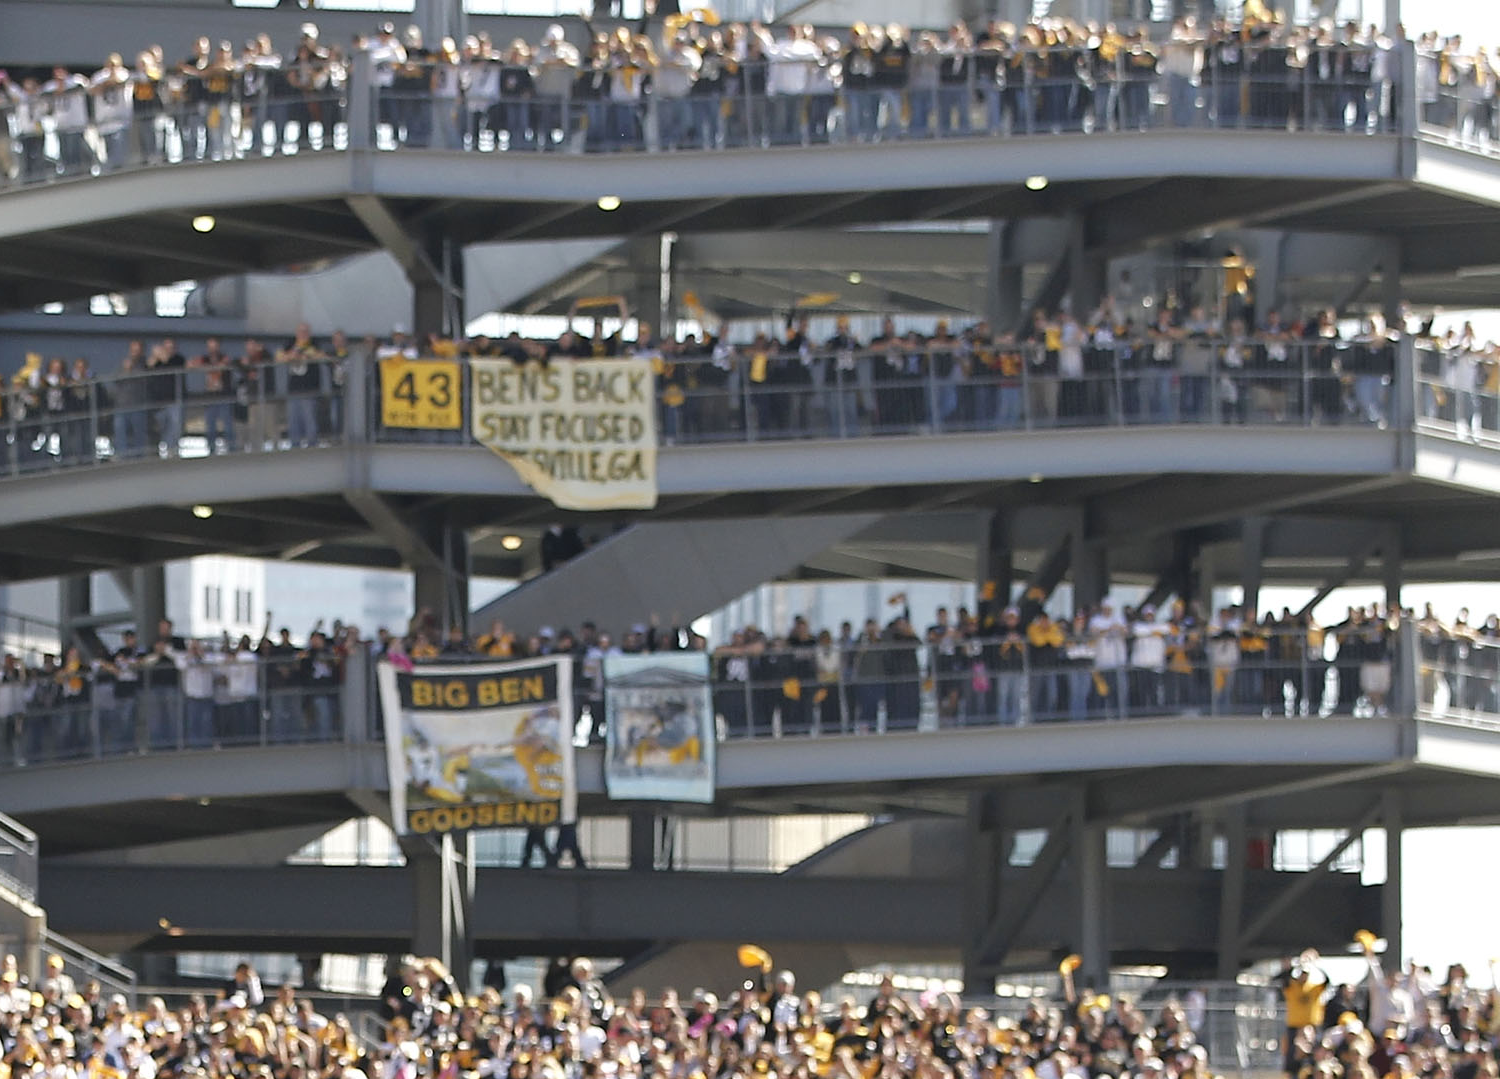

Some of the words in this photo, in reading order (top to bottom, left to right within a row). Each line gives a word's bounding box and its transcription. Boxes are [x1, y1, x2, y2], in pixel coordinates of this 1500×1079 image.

[393, 371, 451, 408] 43
[571, 369, 645, 403] BACK
[479, 413, 534, 443] STAY
[538, 413, 645, 444] FOCUSED
[411, 679, 470, 707] BIG
[477, 675, 545, 707] BEN
